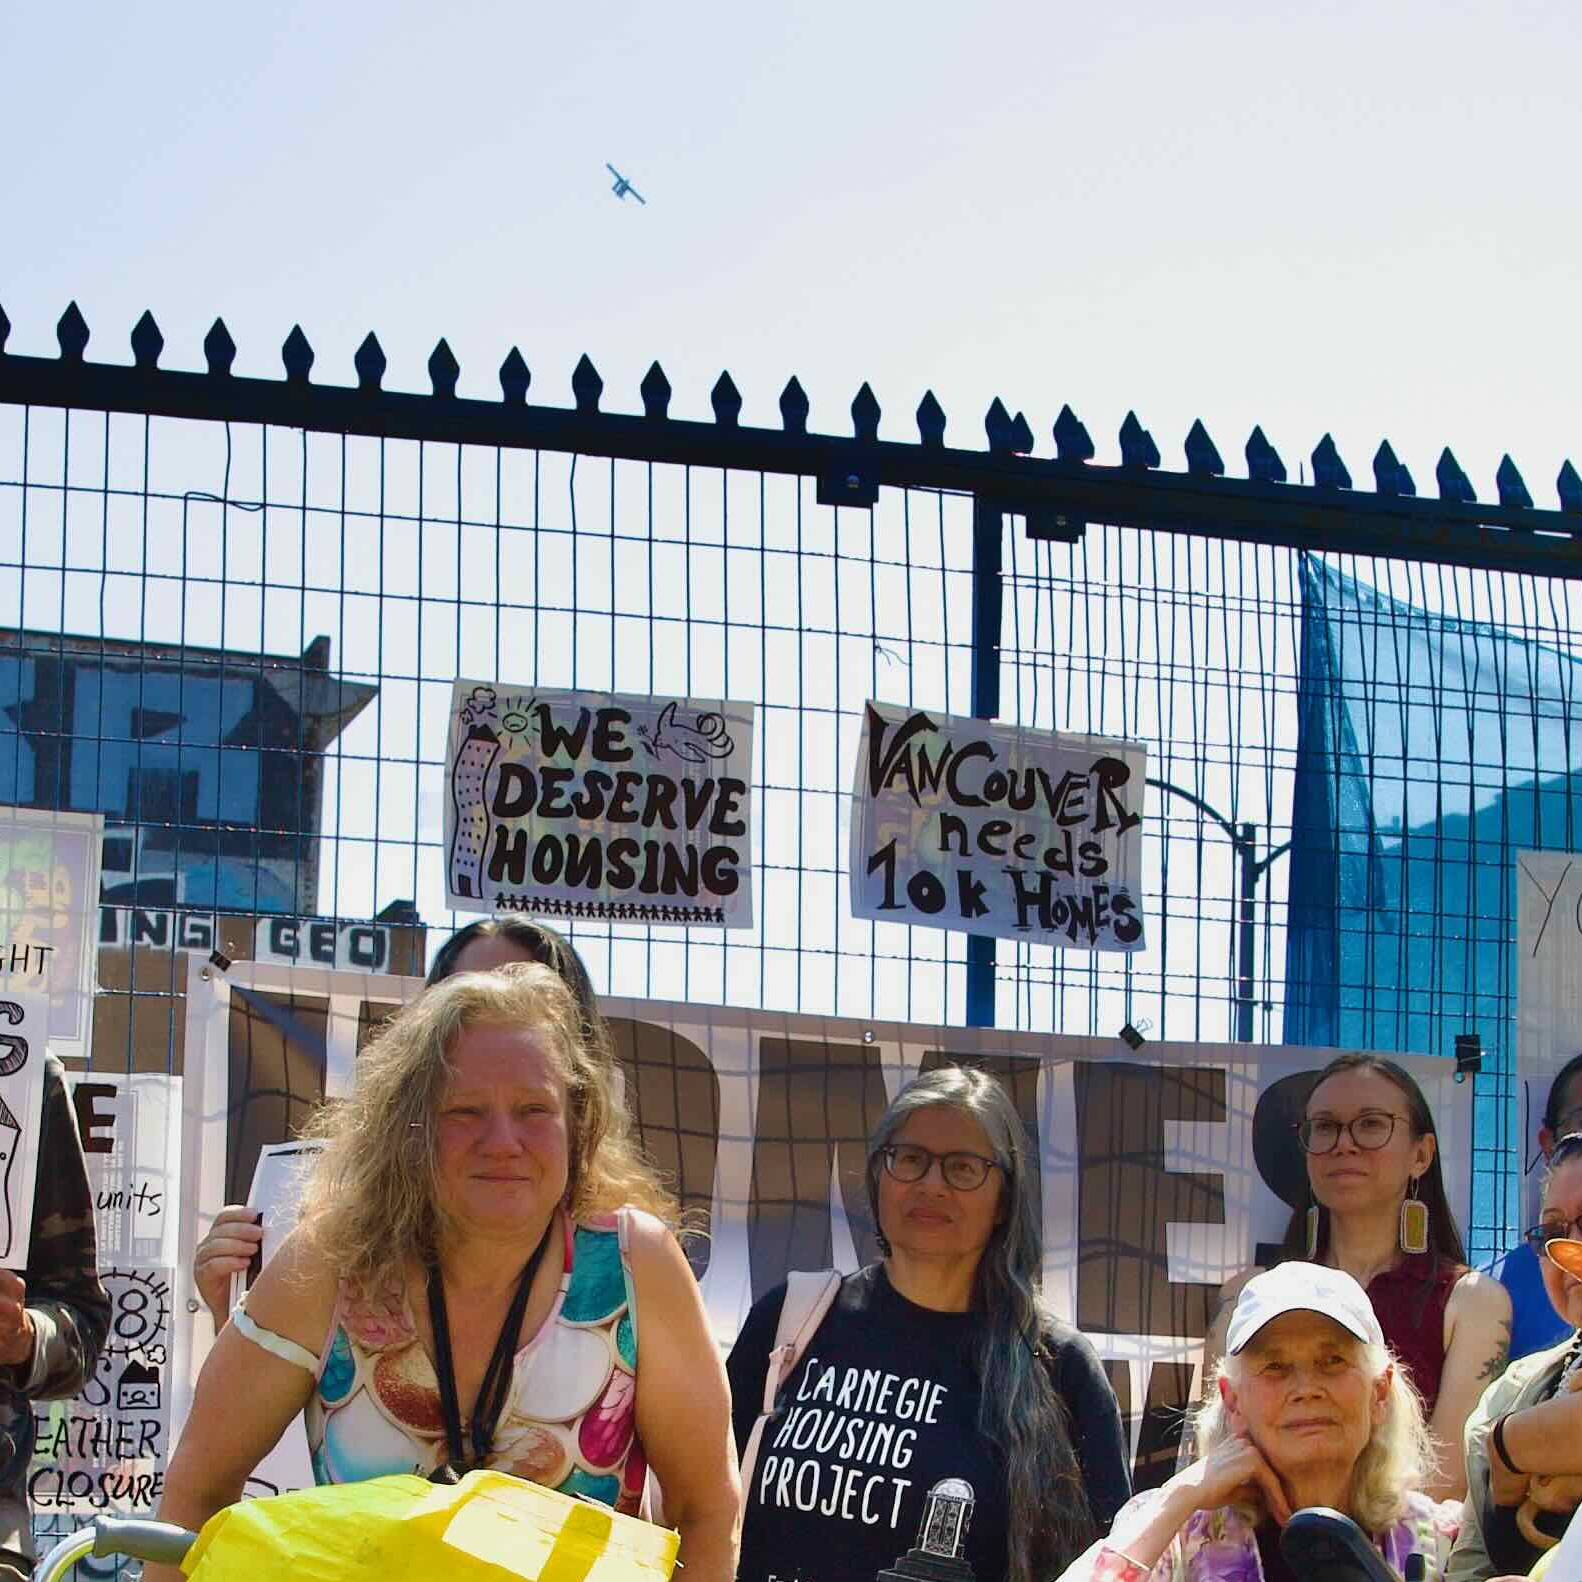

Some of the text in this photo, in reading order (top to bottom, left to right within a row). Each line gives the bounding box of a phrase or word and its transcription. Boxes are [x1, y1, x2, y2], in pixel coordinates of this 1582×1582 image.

[535, 703, 634, 762] WE
[492, 762, 747, 837] DESERVE
[488, 825, 740, 897] HOUSING
[938, 812, 1109, 877] needs
[96, 1182, 163, 1217] units
[796, 1357, 949, 1425] CARNEGIE
[772, 1406, 918, 1469] HOUSING
[27, 1467, 164, 1509] CLOSURE
[760, 1455, 913, 1530] PROJECT
